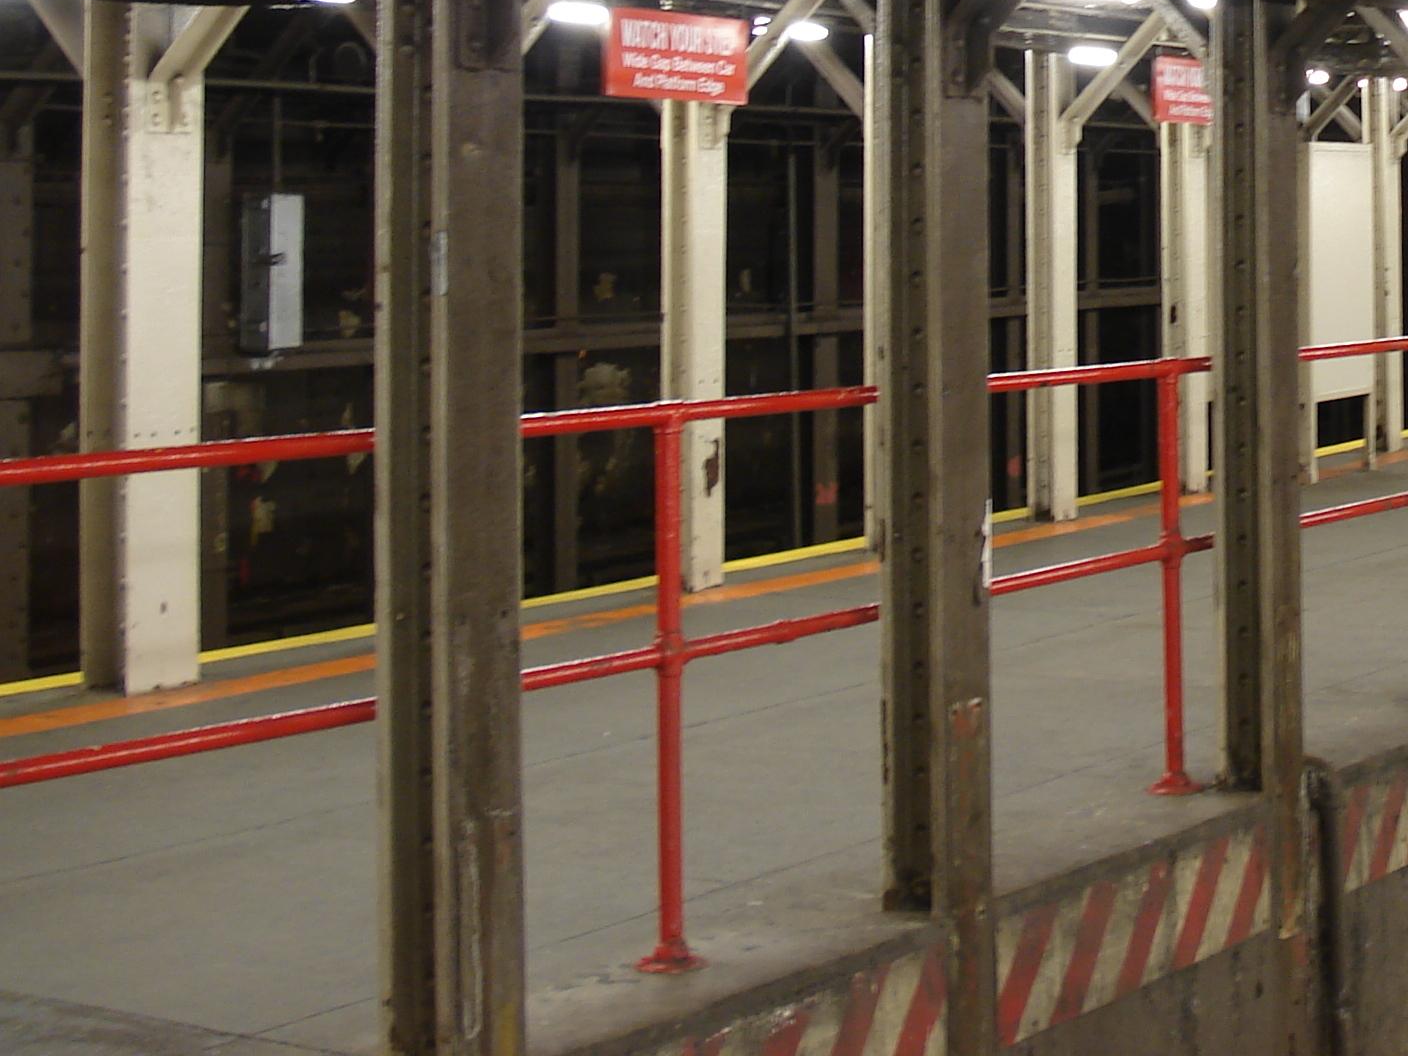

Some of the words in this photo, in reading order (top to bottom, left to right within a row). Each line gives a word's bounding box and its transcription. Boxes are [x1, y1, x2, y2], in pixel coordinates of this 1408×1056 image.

[621, 19, 669, 49] WATCH
[671, 24, 702, 53] YOUR
[621, 52, 649, 68] Wide
[649, 54, 671, 73] Gap
[671, 56, 715, 74] Between
[715, 60, 736, 76] Car
[633, 72, 654, 88] And
[654, 74, 697, 92] Platform
[697, 78, 726, 97] Edge
